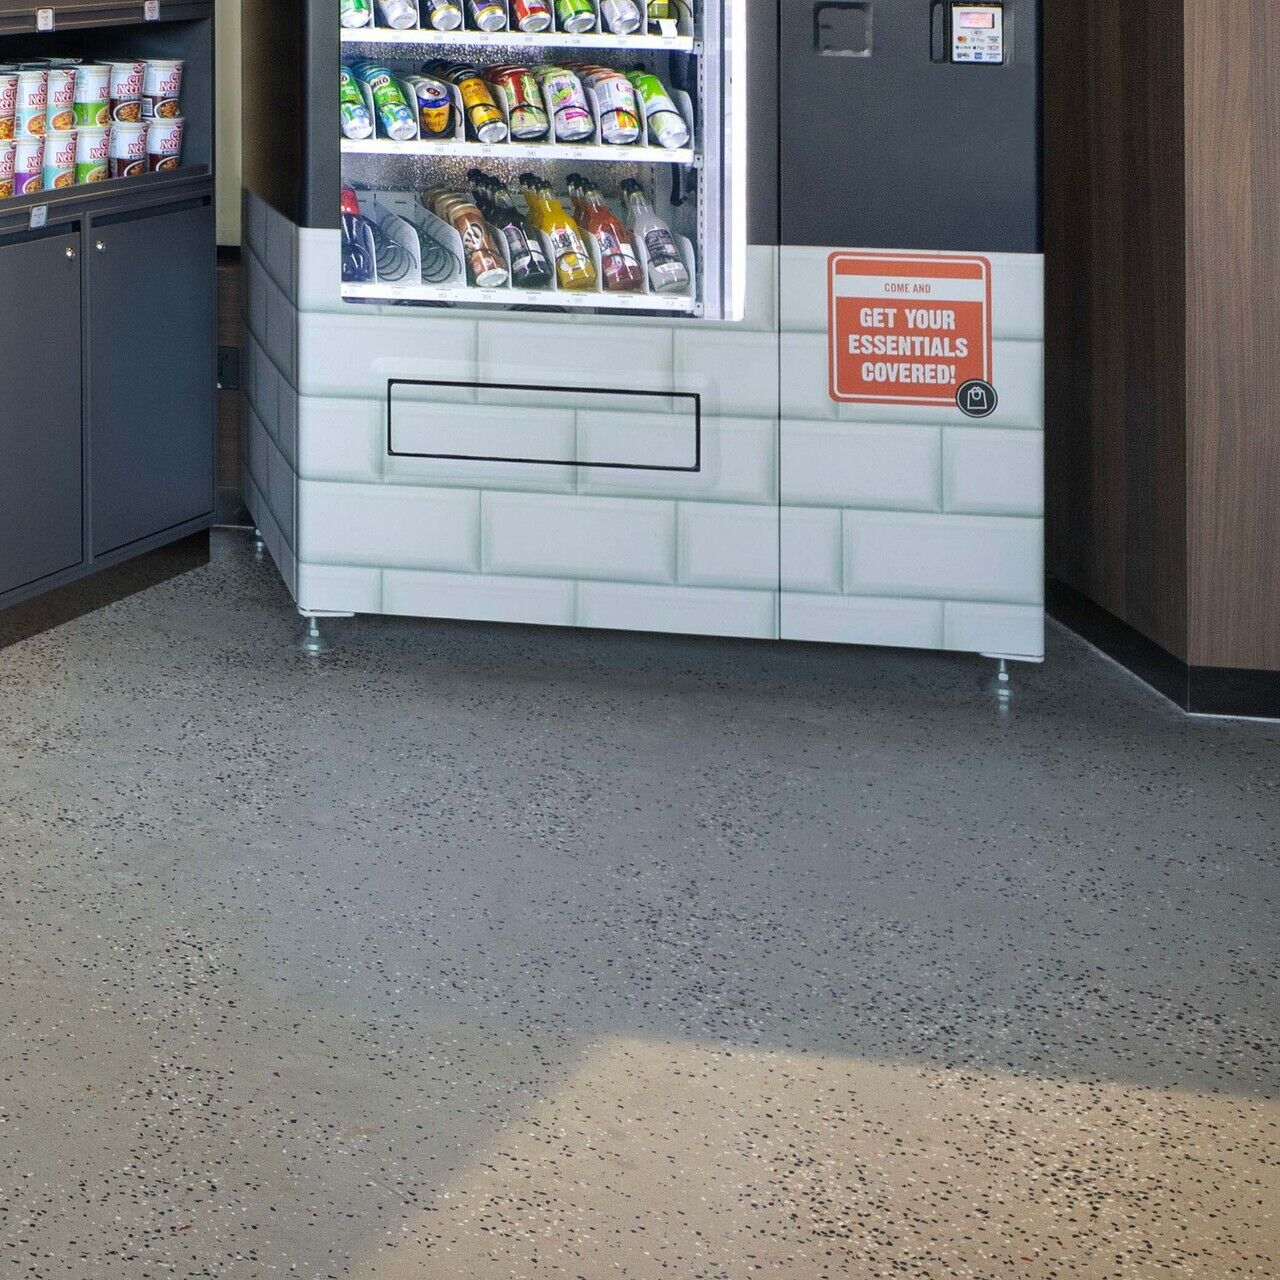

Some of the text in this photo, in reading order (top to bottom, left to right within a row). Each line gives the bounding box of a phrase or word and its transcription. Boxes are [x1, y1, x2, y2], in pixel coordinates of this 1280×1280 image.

[371, 74, 389, 89] MILO
[884, 283, 931, 293] COME AND
[860, 307, 956, 330] GET YOUR
[848, 334, 968, 357] ESSENTIALS
[861, 362, 956, 385] COVERED!
